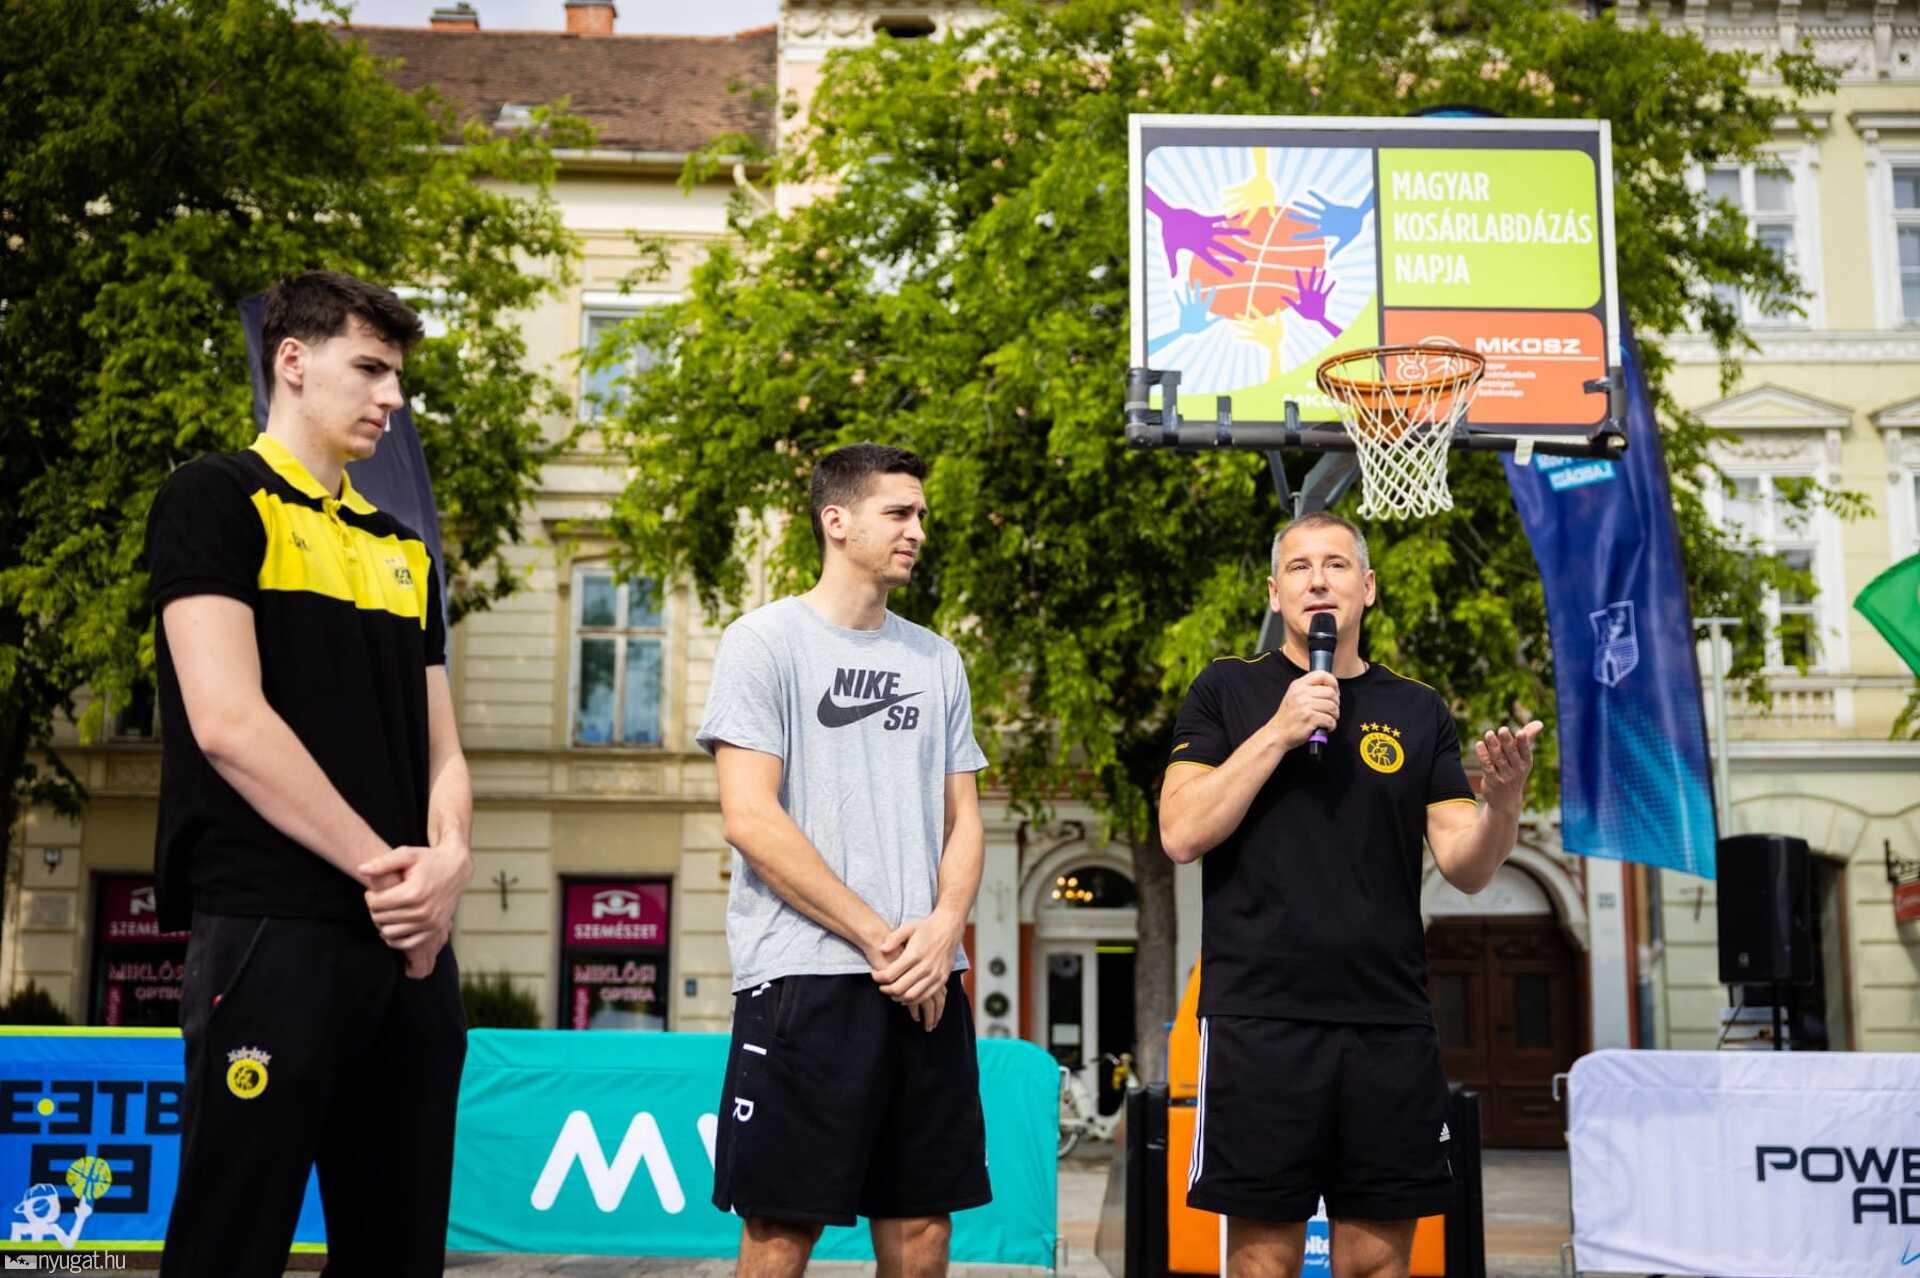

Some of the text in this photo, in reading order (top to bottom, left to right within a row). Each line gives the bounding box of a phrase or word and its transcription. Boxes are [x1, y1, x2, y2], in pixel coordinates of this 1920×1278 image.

[1391, 170, 1490, 201] MAGYAR
[1392, 207, 1593, 244] KOSÁRLABDÁZÁS
[1394, 253, 1470, 285] NAPJA
[1475, 336, 1582, 354] MKOSZ
[833, 667, 901, 699] NIKE
[883, 705, 920, 731] SB
